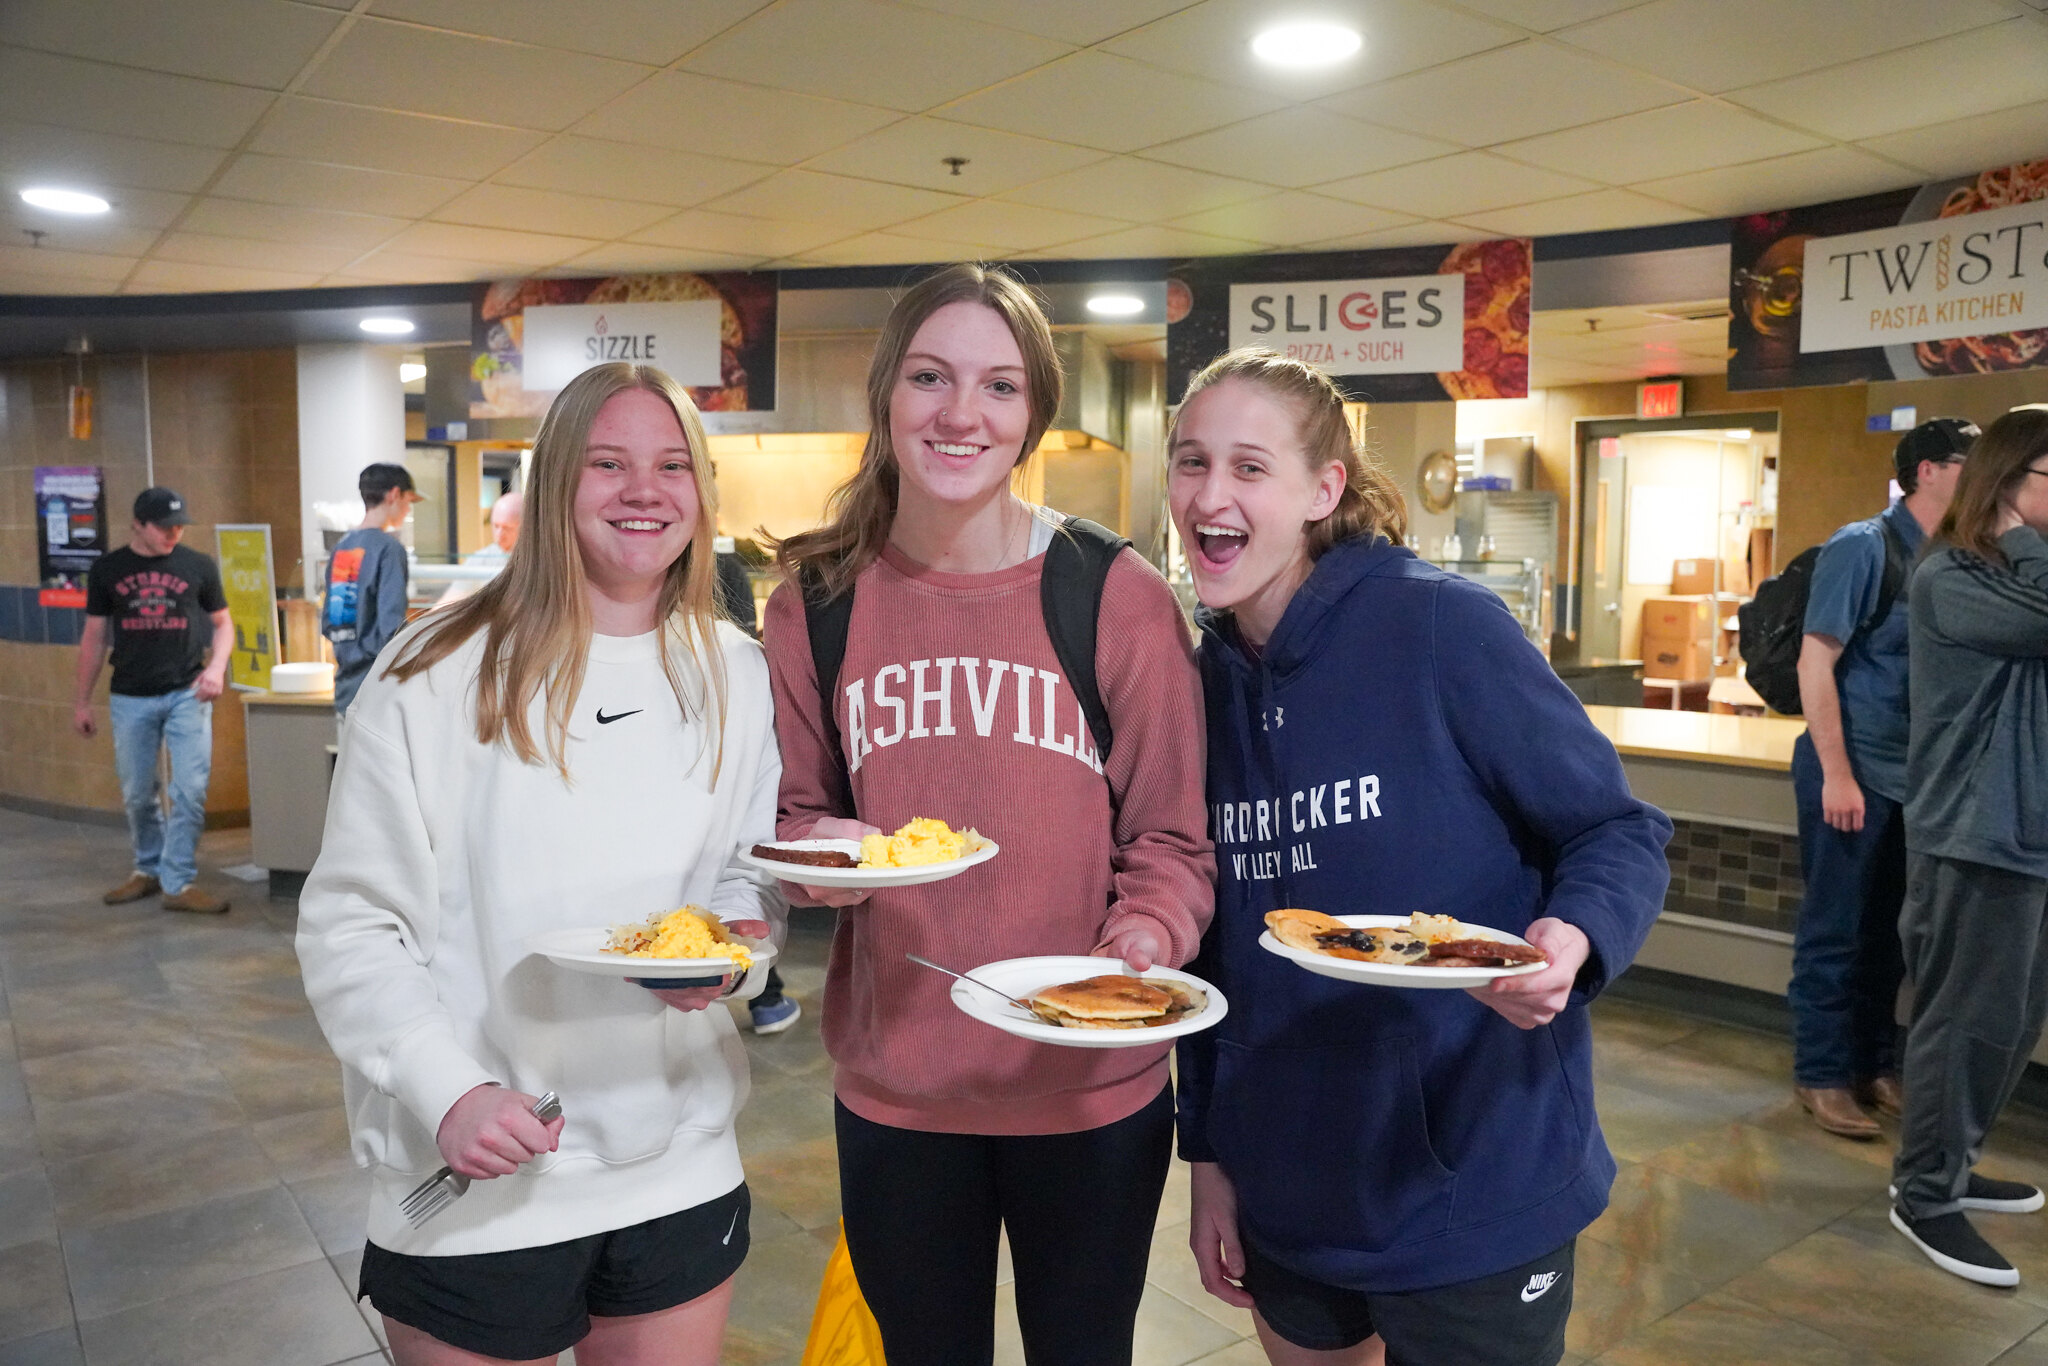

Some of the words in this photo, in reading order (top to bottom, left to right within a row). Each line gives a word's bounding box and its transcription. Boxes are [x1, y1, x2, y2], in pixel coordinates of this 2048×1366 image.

[1827, 222, 2048, 301] TWIST
[1250, 288, 1442, 333] SLICES
[1869, 305, 1930, 331] PASTA
[1935, 291, 2025, 323] KITCHEN
[585, 334, 656, 361] SIZZLE
[1286, 343, 1336, 364] PIZZA
[1340, 346, 1352, 358] +
[1357, 341, 1404, 363] SUCH
[846, 656, 1104, 776] ASHVILL
[1528, 1271, 1556, 1291] NIKE
